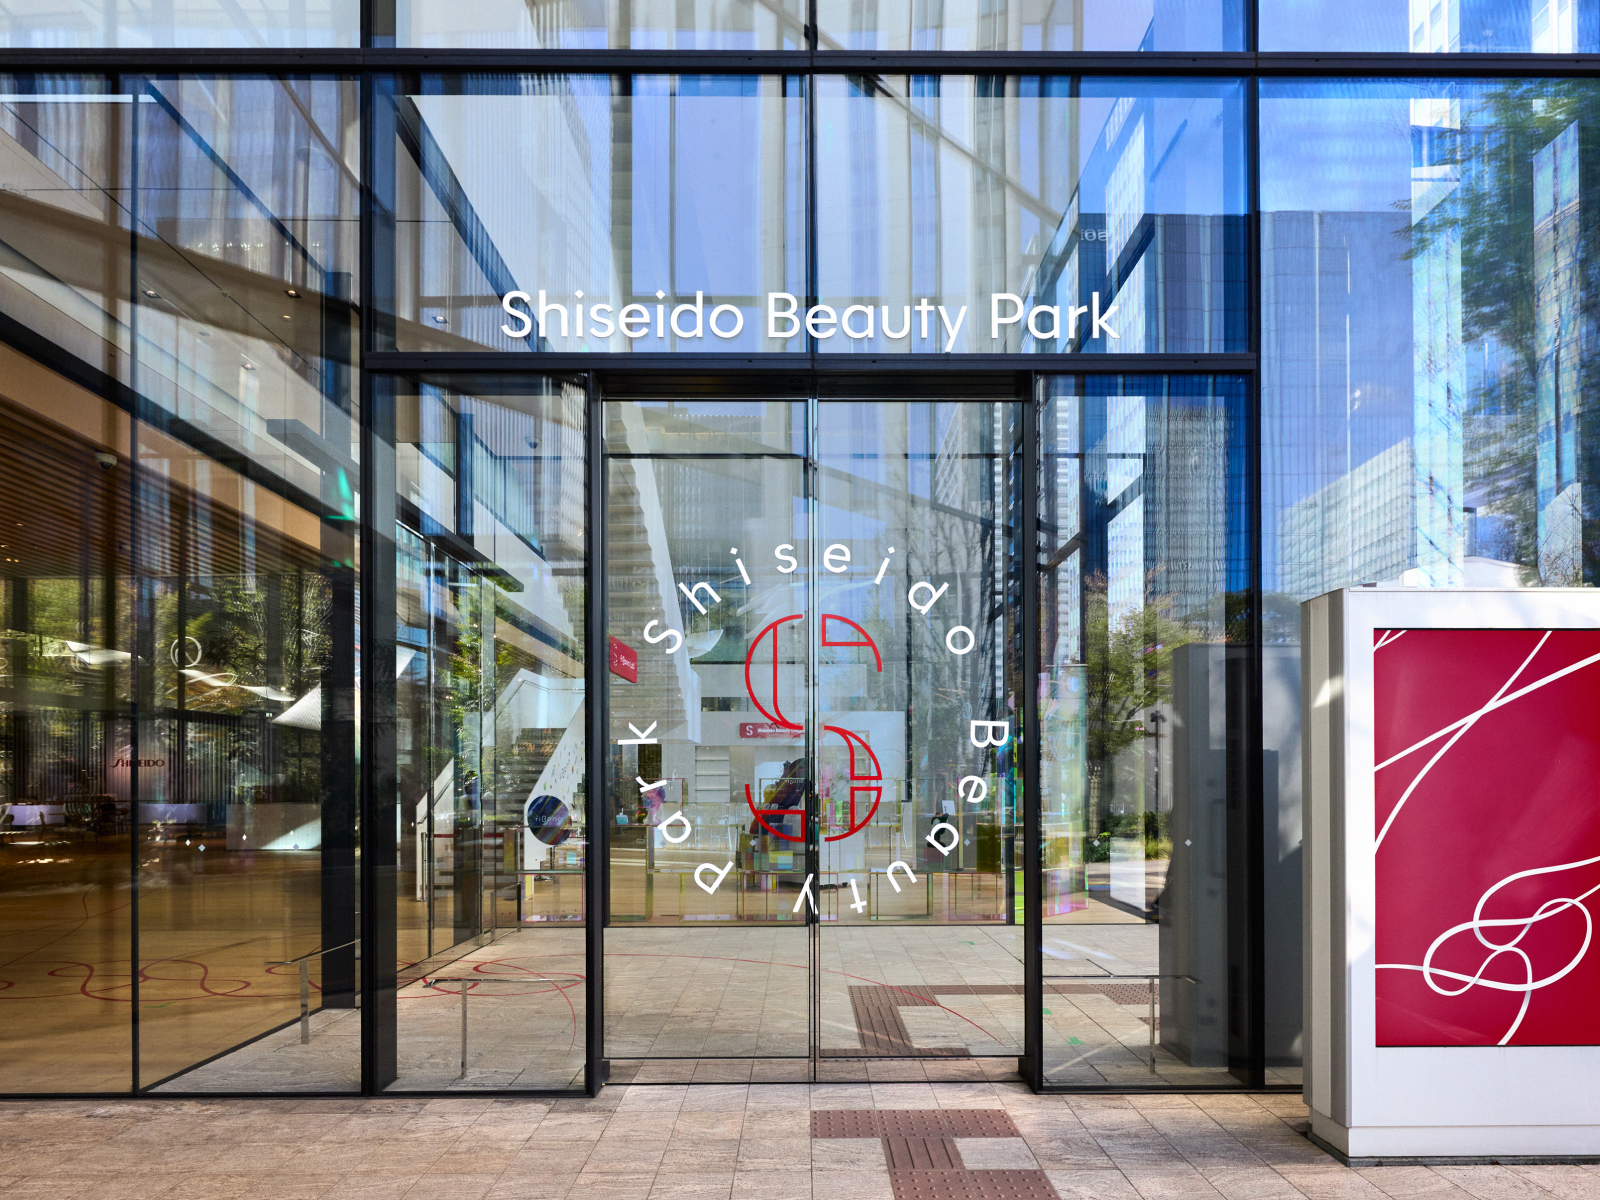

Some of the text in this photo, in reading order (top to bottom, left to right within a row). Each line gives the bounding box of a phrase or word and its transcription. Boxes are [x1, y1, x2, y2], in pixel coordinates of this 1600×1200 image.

[500, 290, 1121, 353] Shiseido Beauty Park
[617, 543, 1009, 914] Shiseido Beauty Park
[110, 757, 165, 768] SHIEIDO
